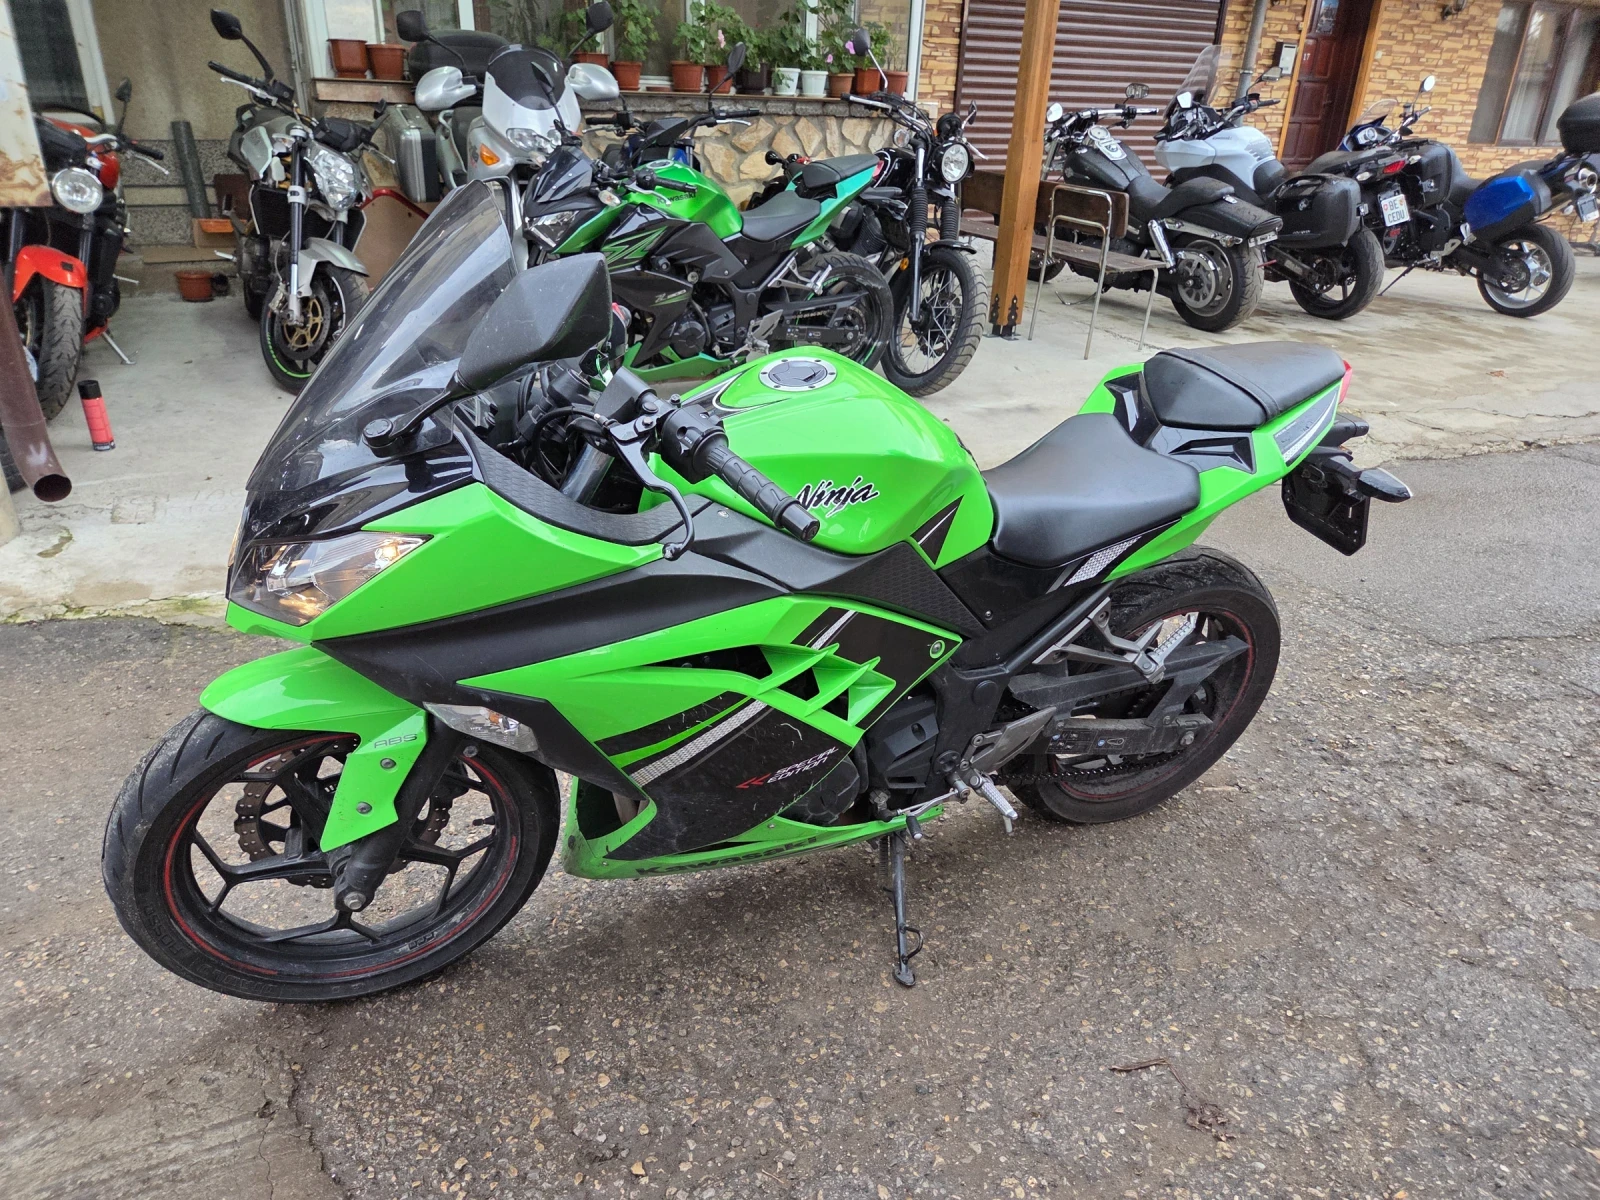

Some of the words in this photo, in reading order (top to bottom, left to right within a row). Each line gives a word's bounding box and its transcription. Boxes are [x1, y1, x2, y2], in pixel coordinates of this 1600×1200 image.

[1389, 200, 1399, 211] BE
[796, 475, 880, 518] Ninja
[374, 733, 418, 749] ABS
[766, 756, 828, 784] EDITION
[776, 746, 839, 775] SPECIAL
[635, 836, 817, 876] Kawasaki
